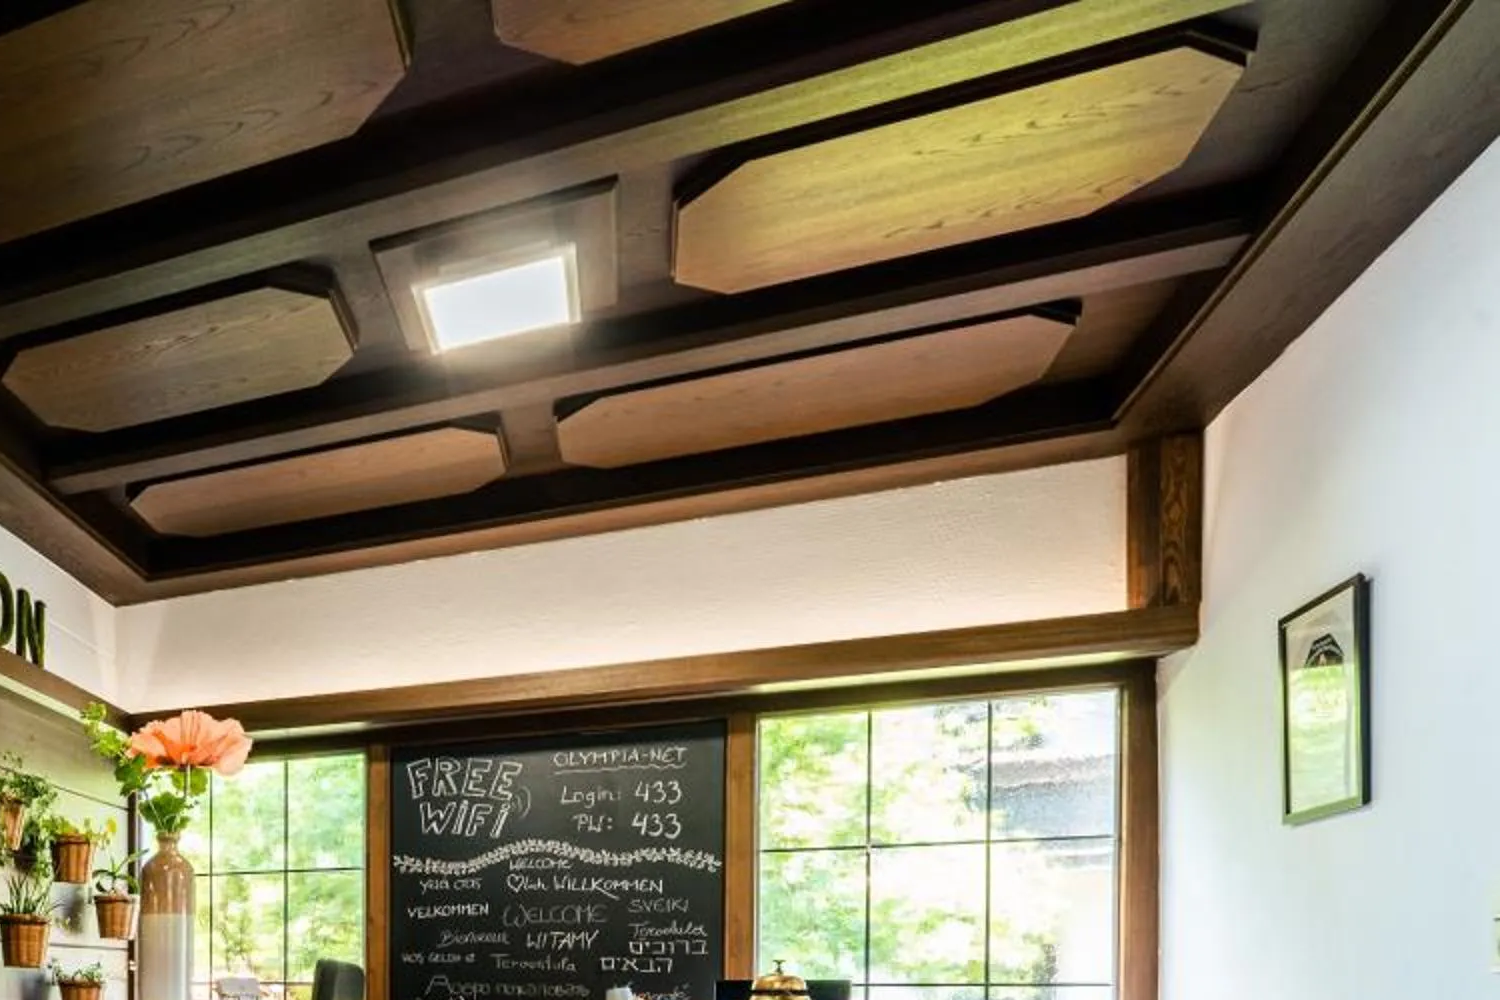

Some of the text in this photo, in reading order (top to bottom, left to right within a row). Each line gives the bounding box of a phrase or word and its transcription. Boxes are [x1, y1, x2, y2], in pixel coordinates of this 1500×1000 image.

[553, 746, 687, 767] OLYMPIA-NET
[406, 758, 523, 800] FREE
[634, 780, 683, 805] 433
[631, 812, 682, 839] 433
[553, 875, 663, 900] WILLKOMMEN
[407, 903, 489, 919] VELKOMMEN
[526, 929, 599, 950] WITAMY
